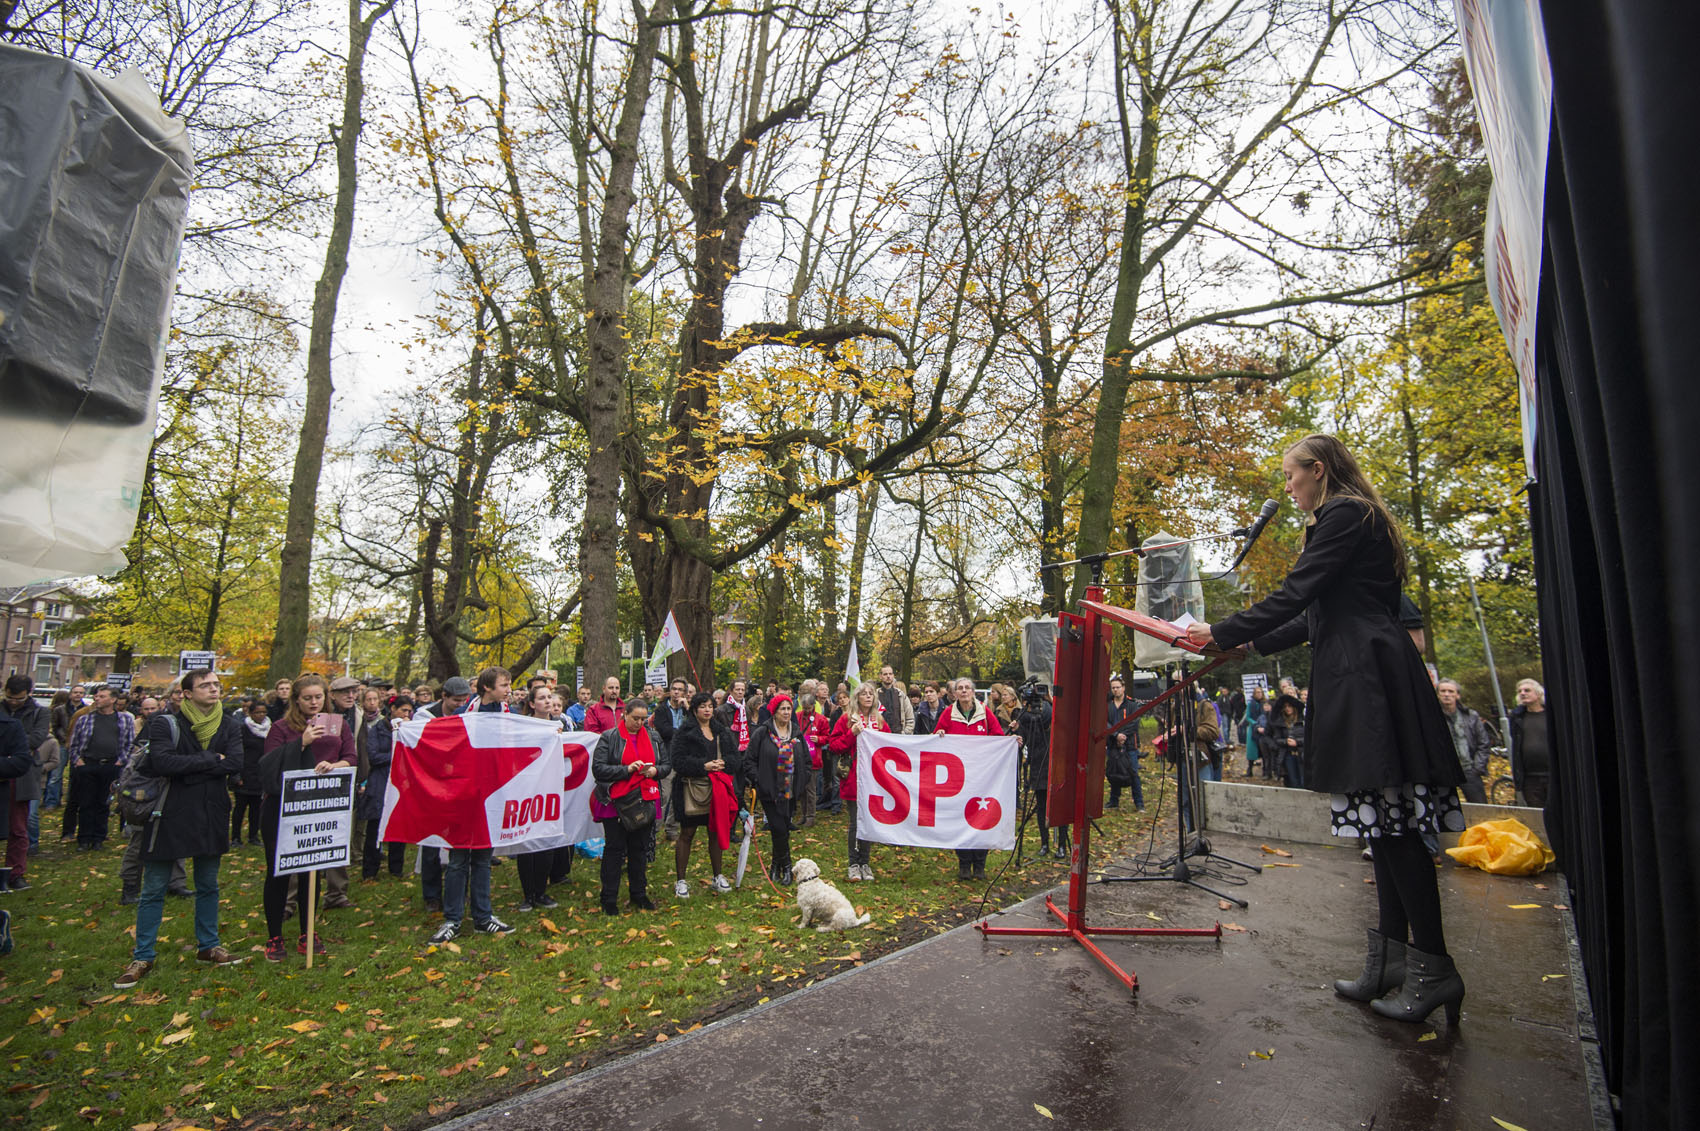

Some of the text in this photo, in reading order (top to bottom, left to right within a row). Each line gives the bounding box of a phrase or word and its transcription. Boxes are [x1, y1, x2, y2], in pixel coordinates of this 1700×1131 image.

[294, 777, 341, 791] GELD VOOR
[284, 797, 350, 813] VLUCHTELINGEN
[502, 793, 560, 829] ROOD
[293, 820, 338, 835] NIET VOOR
[297, 835, 333, 849] WAPENS
[280, 848, 346, 868] SOCIALISME.NU
